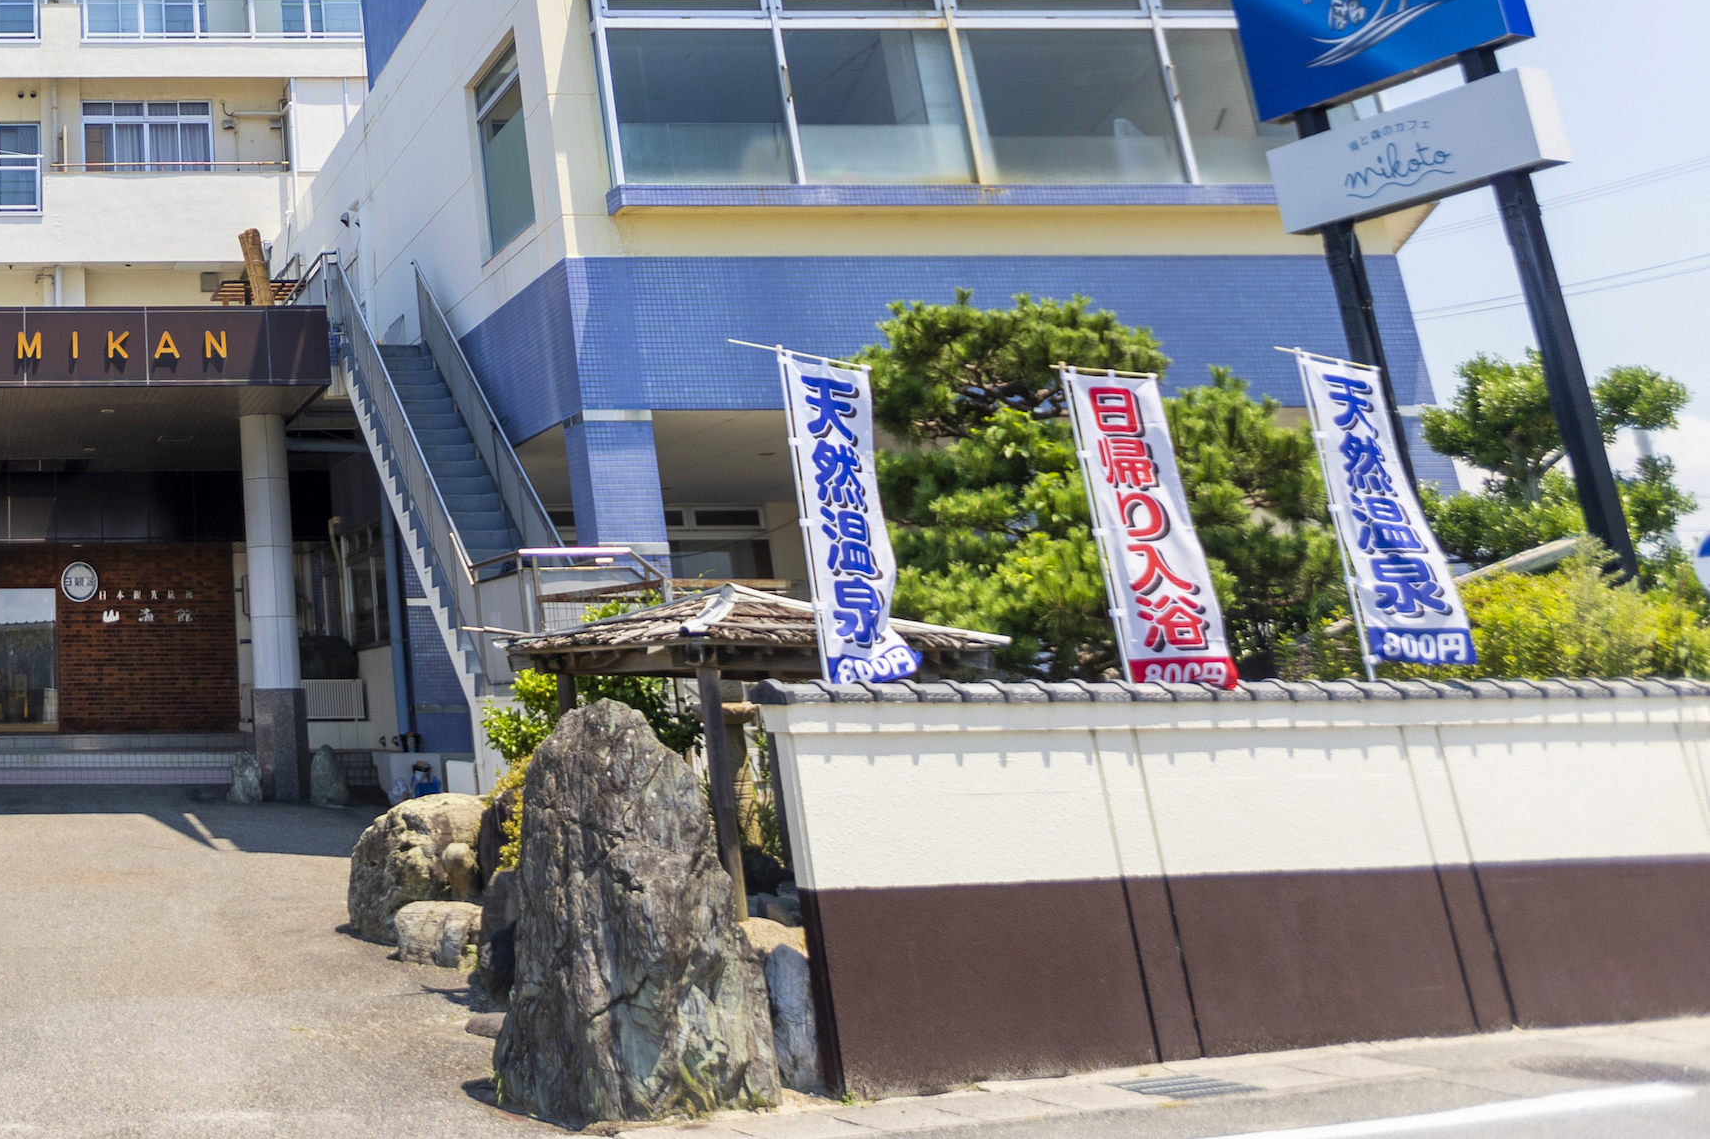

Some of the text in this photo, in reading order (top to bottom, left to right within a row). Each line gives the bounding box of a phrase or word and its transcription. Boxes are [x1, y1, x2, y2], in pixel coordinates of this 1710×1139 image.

[1344, 142, 1451, 188] mikoto
[801, 374, 886, 647] 天然温泉
[1088, 386, 1209, 652] 日帰り入浴
[1322, 373, 1453, 617] 天然温泉
[837, 646, 918, 684] 800円
[1383, 632, 1466, 661] 800円
